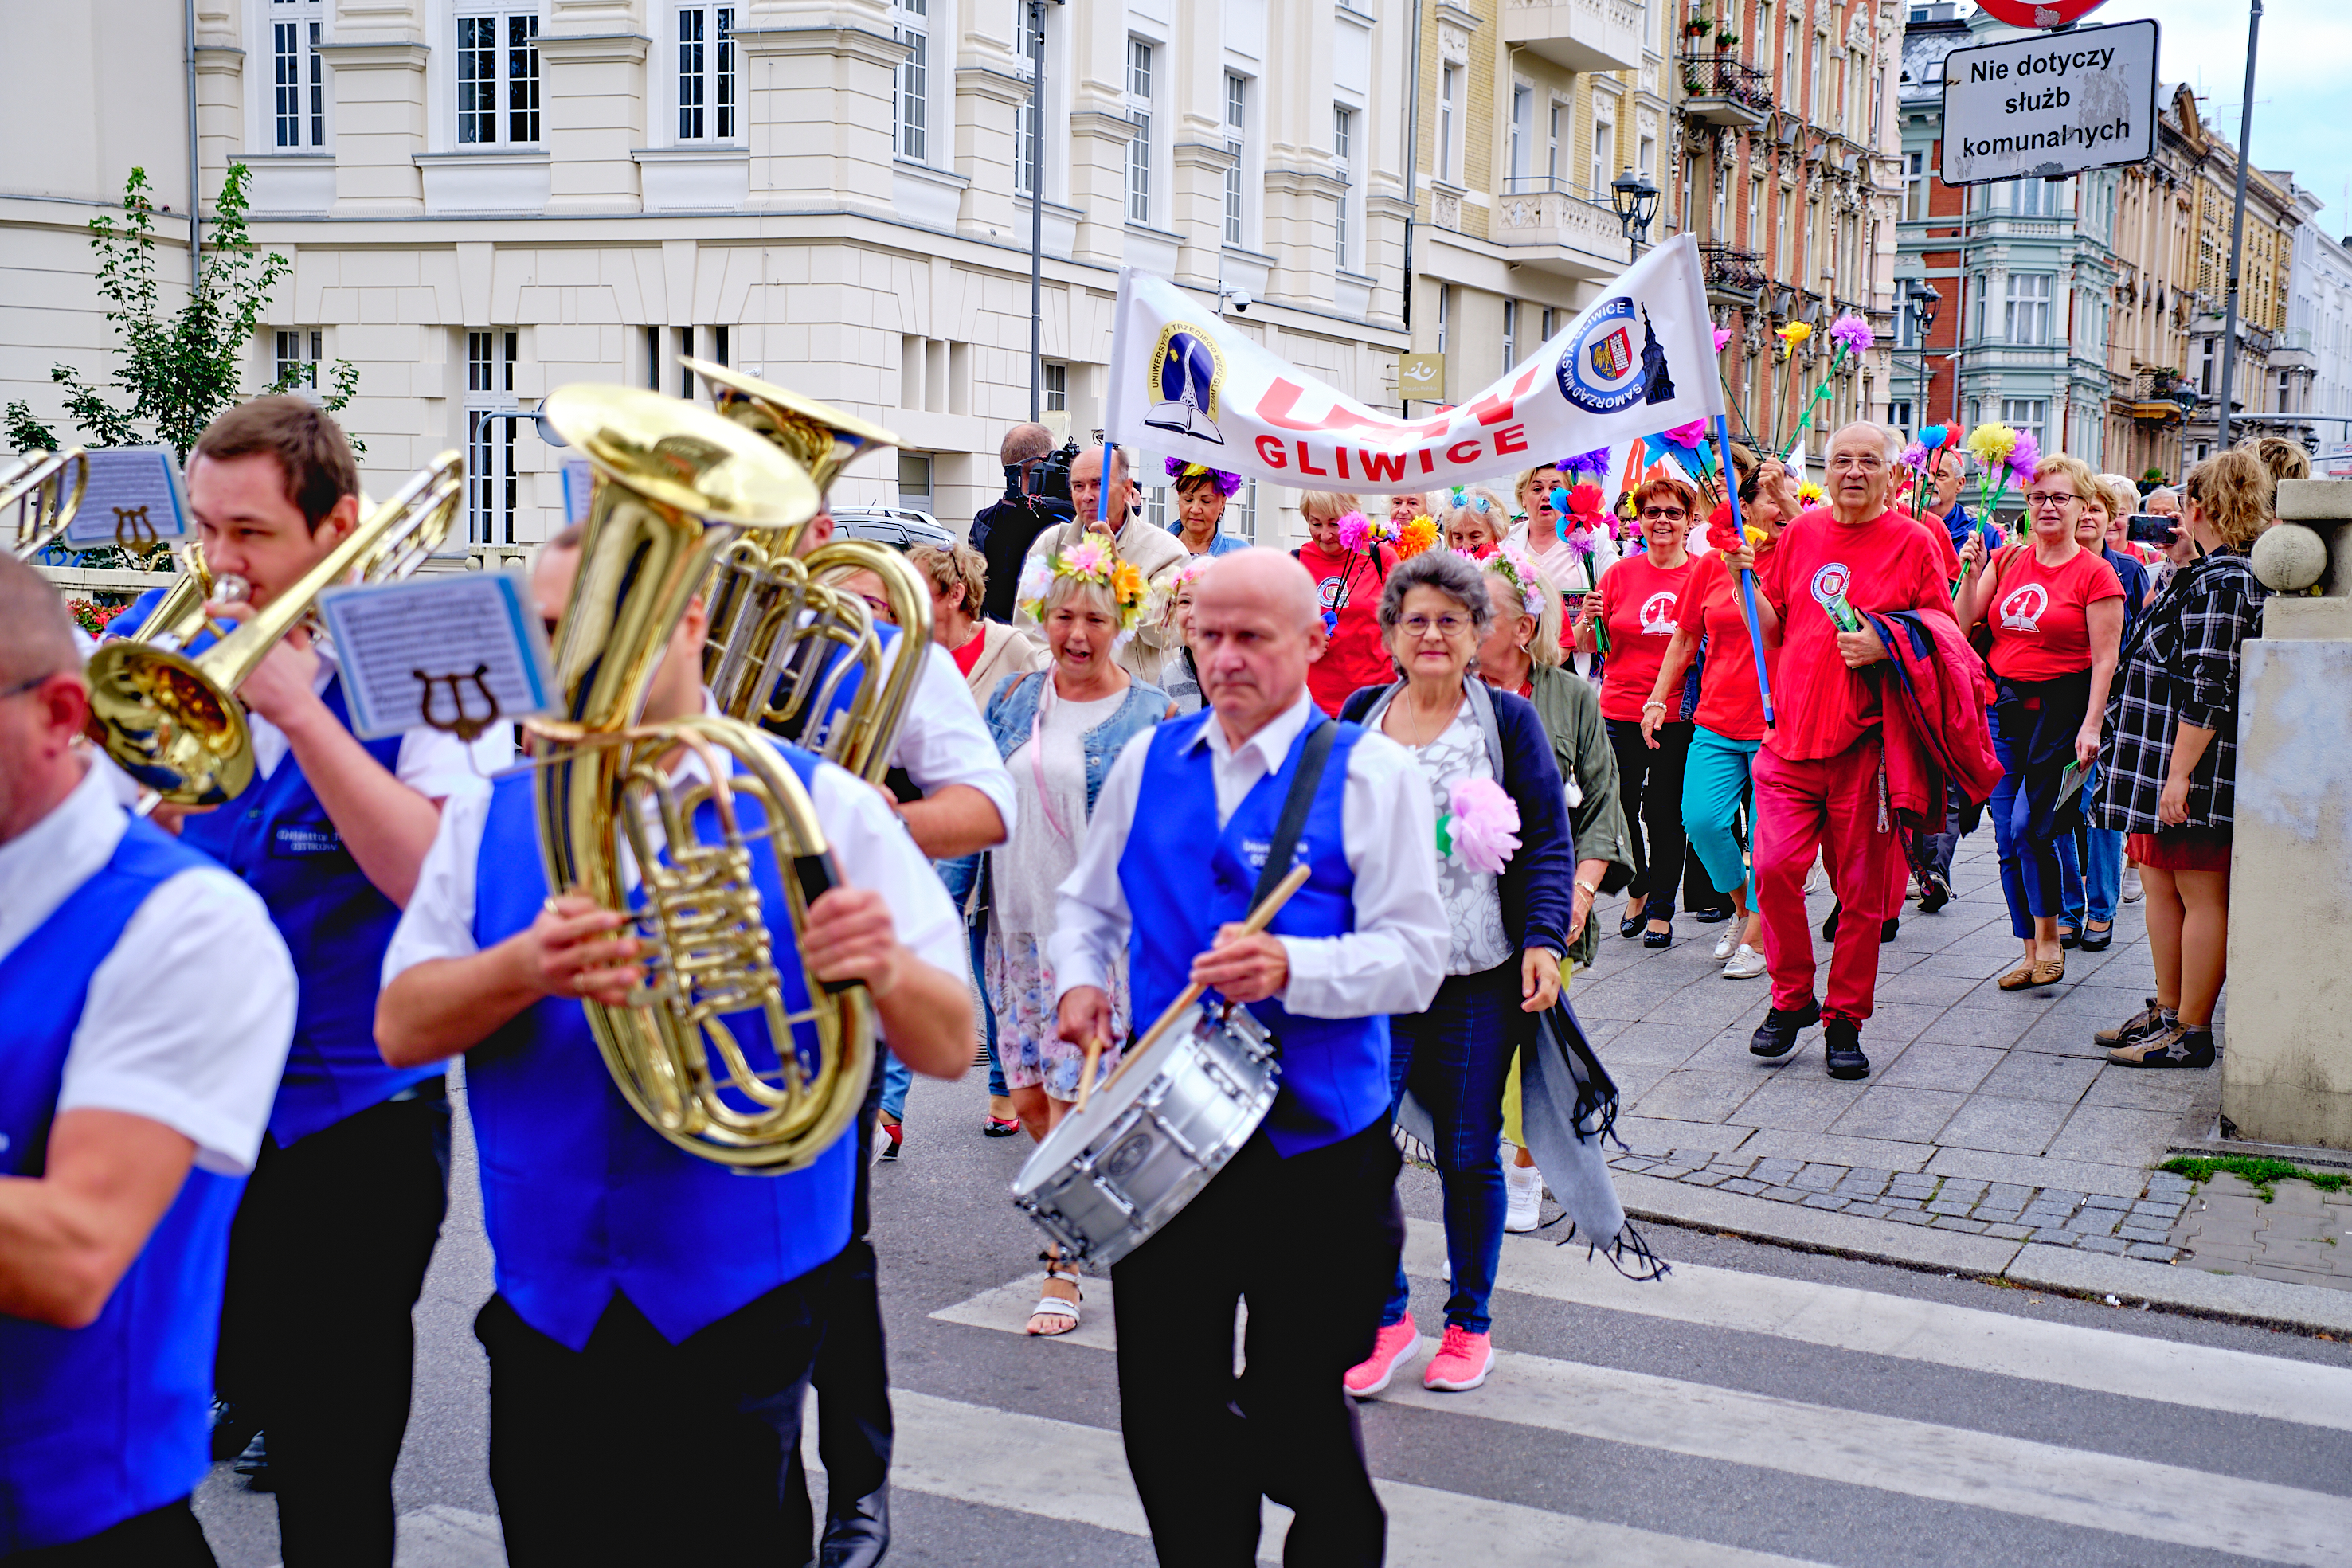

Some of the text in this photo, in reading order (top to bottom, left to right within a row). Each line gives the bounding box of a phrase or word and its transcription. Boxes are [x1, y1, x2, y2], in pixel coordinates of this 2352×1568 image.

[1971, 47, 2115, 84] Nie dotyczy
[2005, 86, 2071, 115] służb
[1963, 117, 2130, 158] komunalnych
[1152, 323, 1223, 413] UNIWERSYTET TRZECIEGO WIEKU GLIWICE
[1562, 302, 1642, 409] SAMORZĄD MIASTA GLIWICE
[1254, 423, 1529, 483] GLIWICE
